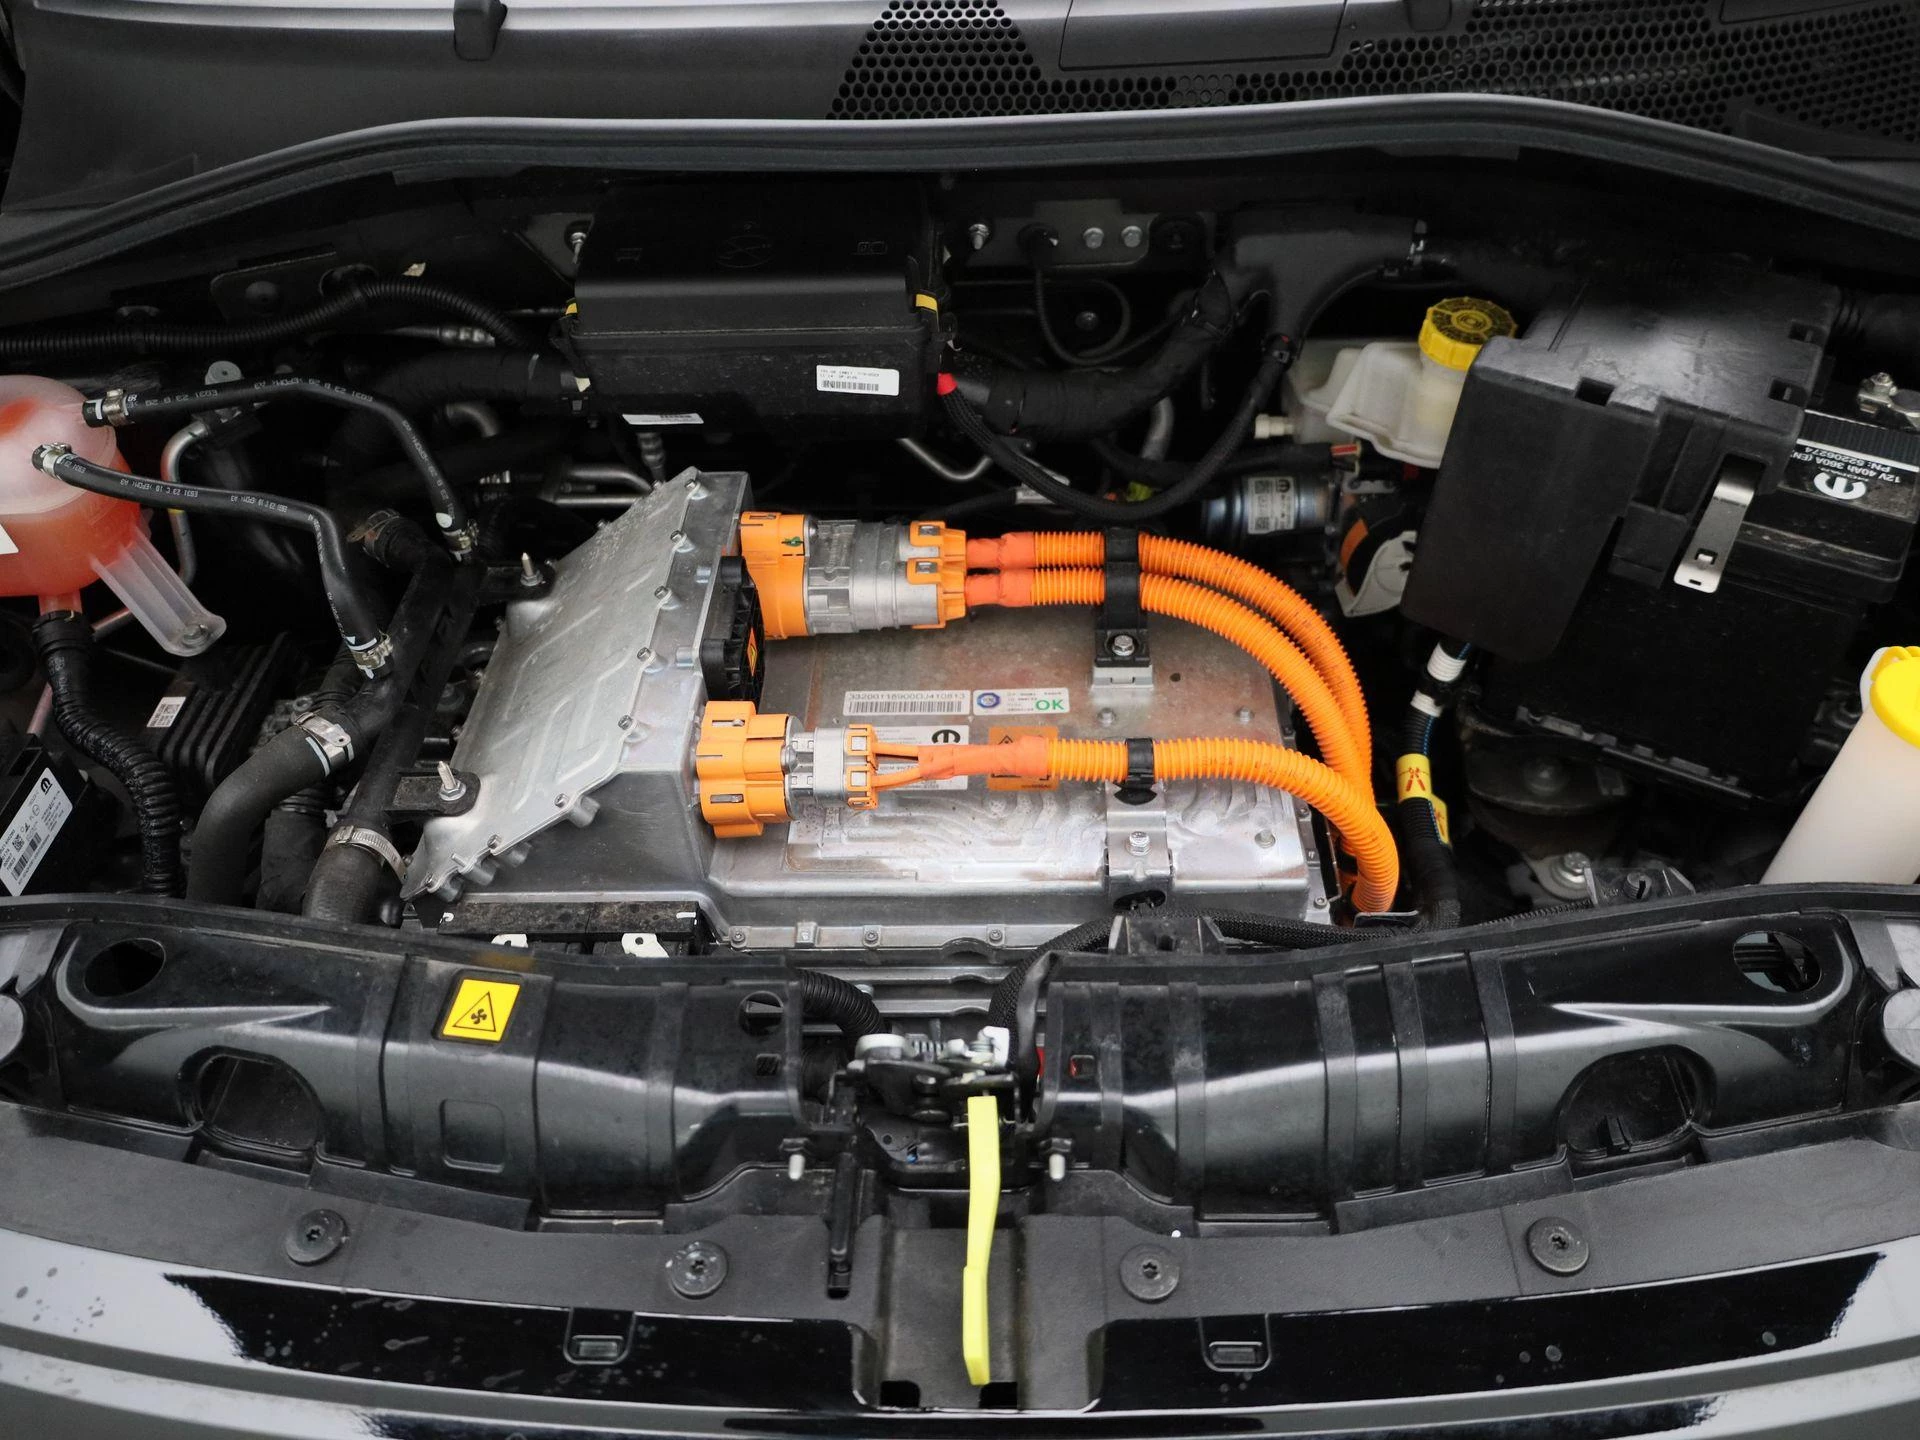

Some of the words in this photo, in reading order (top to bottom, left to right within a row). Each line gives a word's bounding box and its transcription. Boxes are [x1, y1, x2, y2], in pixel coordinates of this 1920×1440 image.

[1804, 446, 1866, 467] 52206274
[1815, 456, 1844, 469] 360A
[1847, 464, 1877, 478] 40Ah
[1867, 461, 1891, 473] PN:
[1878, 472, 1901, 483] 12V
[1035, 698, 1065, 711] OK
